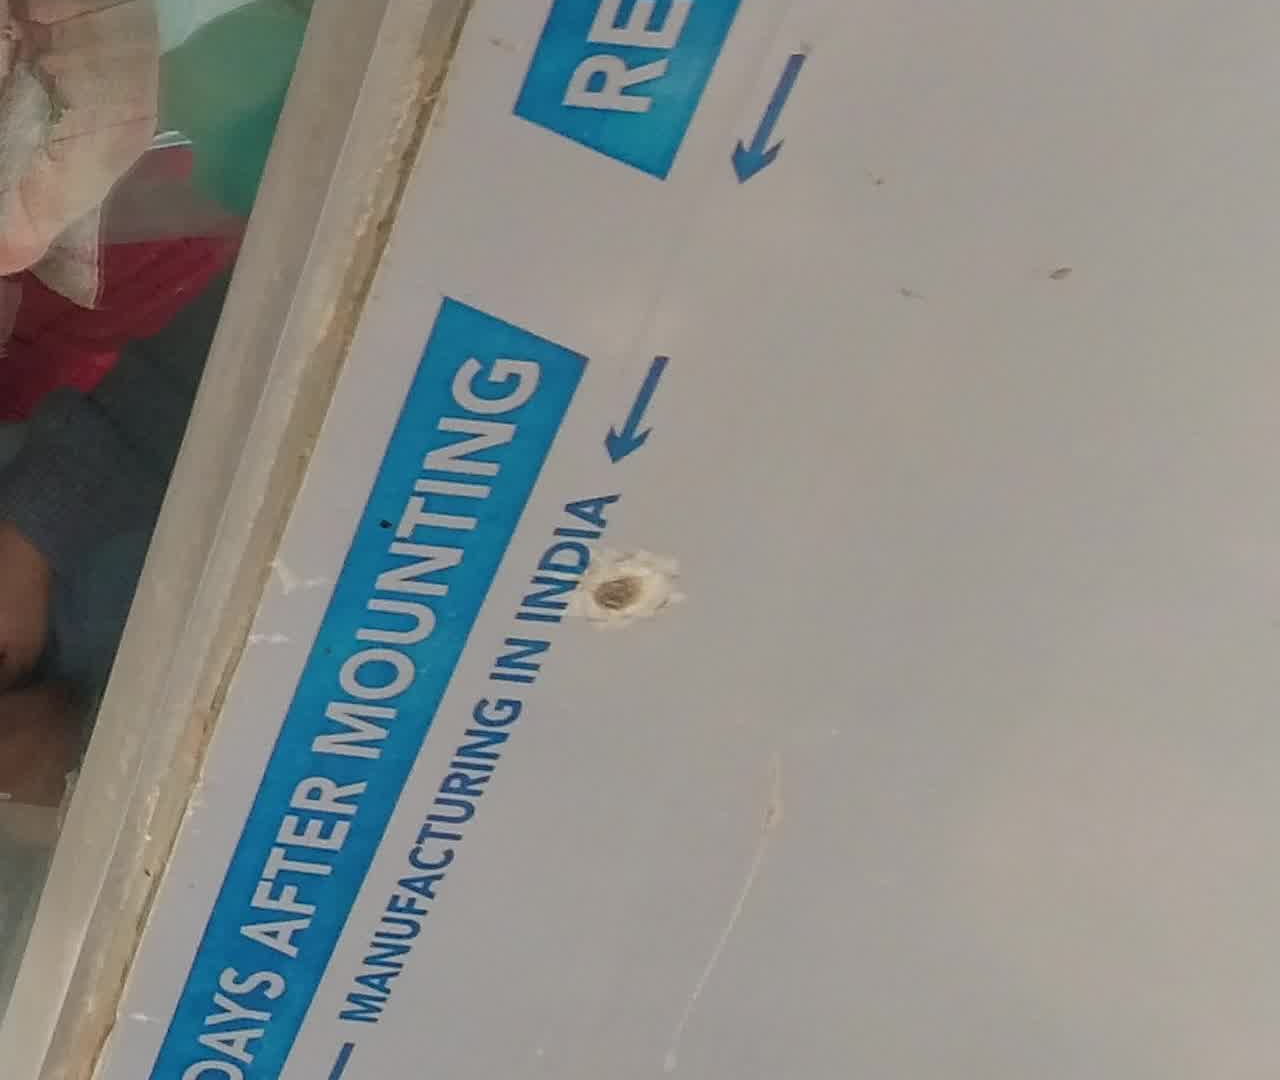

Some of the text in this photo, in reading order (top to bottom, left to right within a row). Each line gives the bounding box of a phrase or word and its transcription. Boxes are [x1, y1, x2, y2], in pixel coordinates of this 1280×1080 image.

[240, 777, 368, 959] AFTER
[312, 357, 542, 760] MOUNTING
[338, 493, 621, 1023] MANUFACTURING IN INDIA
